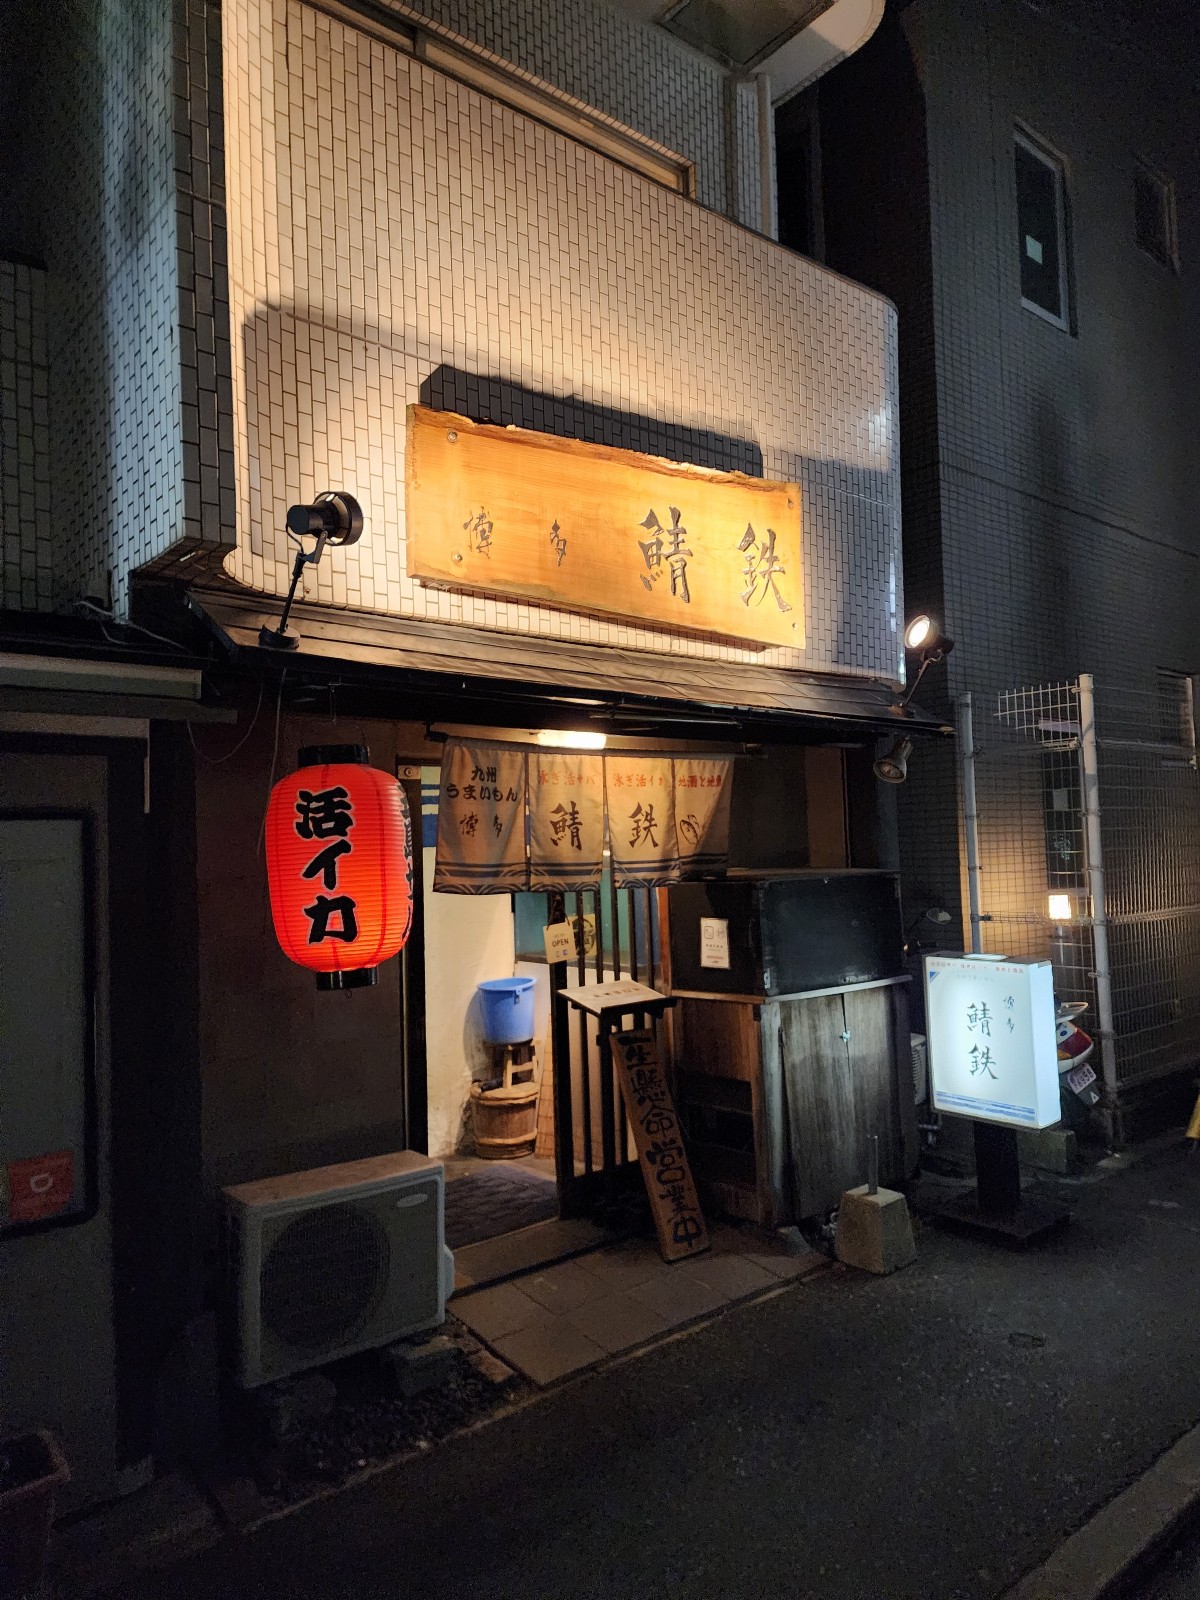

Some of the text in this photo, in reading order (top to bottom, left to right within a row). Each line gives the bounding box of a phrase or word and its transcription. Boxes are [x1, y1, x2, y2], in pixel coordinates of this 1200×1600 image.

[471, 765, 497, 783] 九州
[446, 783, 518, 802] うまいもん
[295, 786, 358, 944] 活イカ
[552, 938, 569, 947] OPEN
